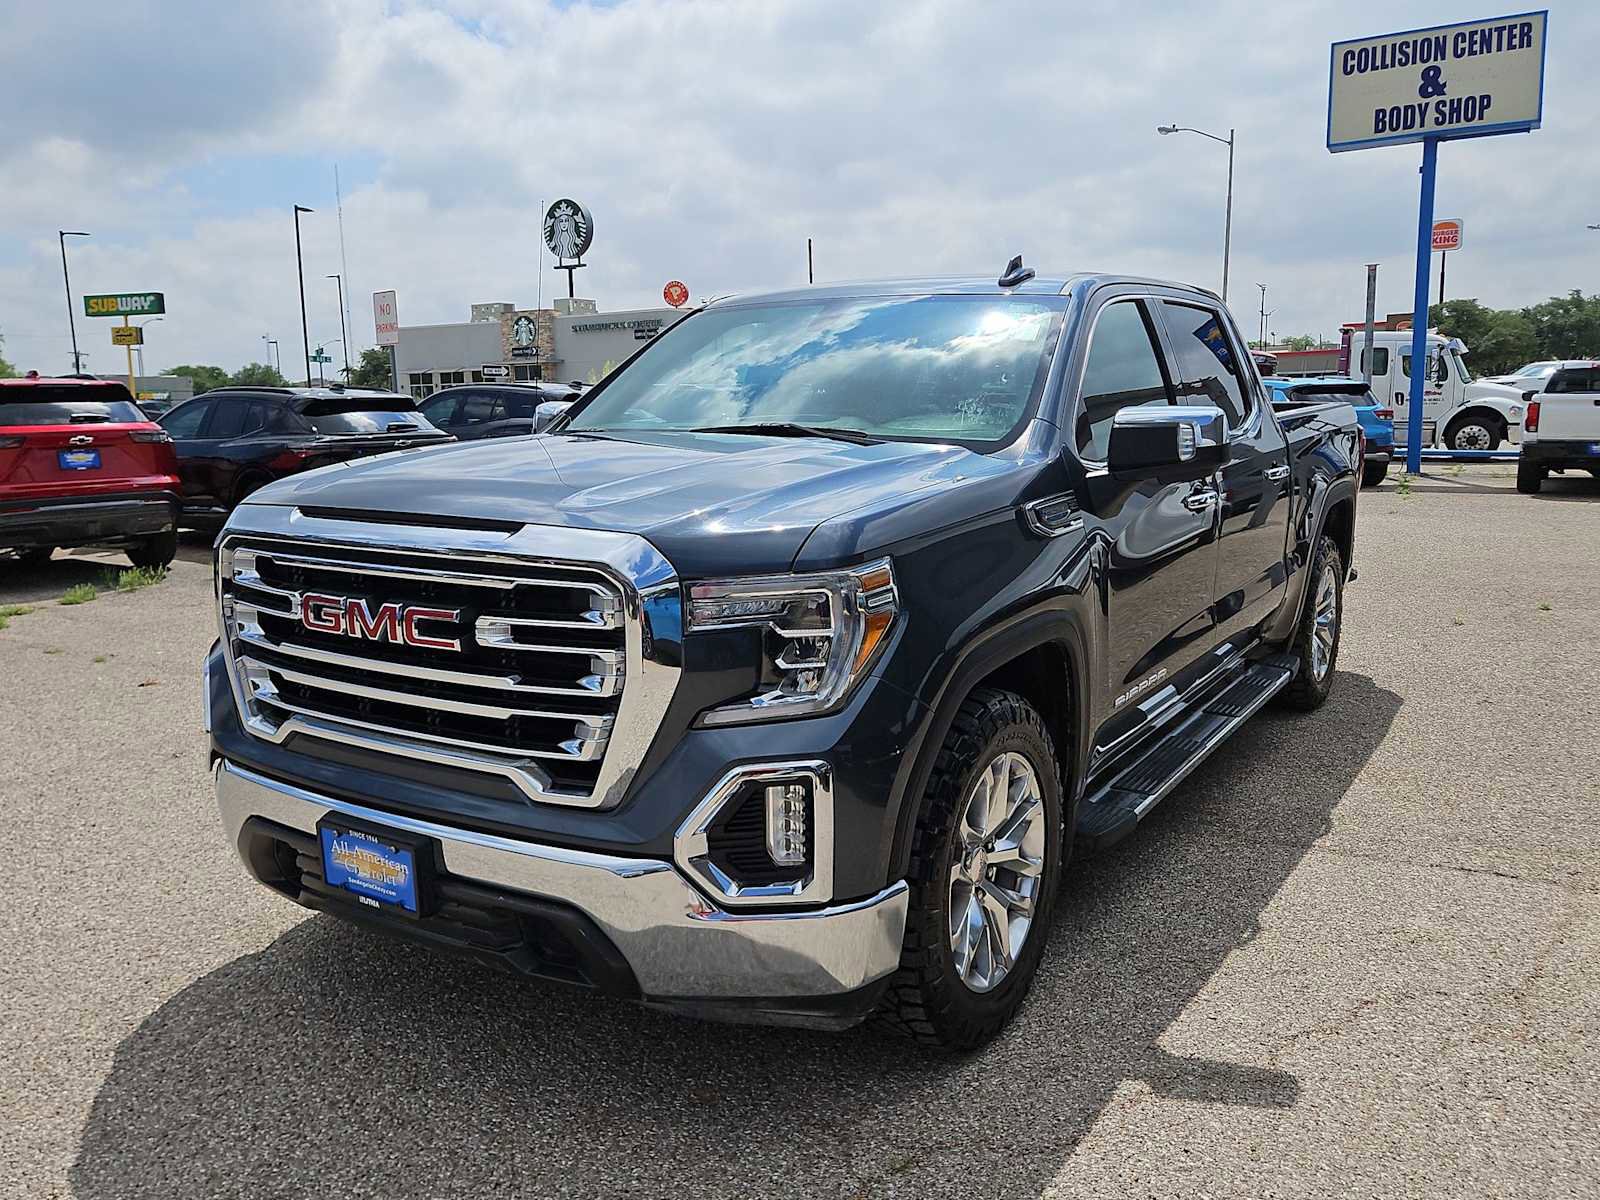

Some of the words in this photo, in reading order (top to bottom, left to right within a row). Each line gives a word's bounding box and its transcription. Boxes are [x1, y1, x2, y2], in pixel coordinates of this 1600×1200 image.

[1342, 35, 1447, 76] COLLISION
[1452, 22, 1533, 59] CENTER
[1418, 65, 1447, 98] &
[1374, 101, 1430, 134] BODY
[1434, 94, 1492, 127] SHOP
[1432, 235, 1458, 244] KING
[87, 295, 152, 313] SUBWAY
[379, 303, 391, 316] NO
[376, 322, 399, 334] PARKING
[302, 592, 462, 652] GMC
[1113, 666, 1168, 710] SIERRA
[349, 829, 366, 841] SINCE
[331, 839, 350, 856] All
[353, 845, 409, 876] American
